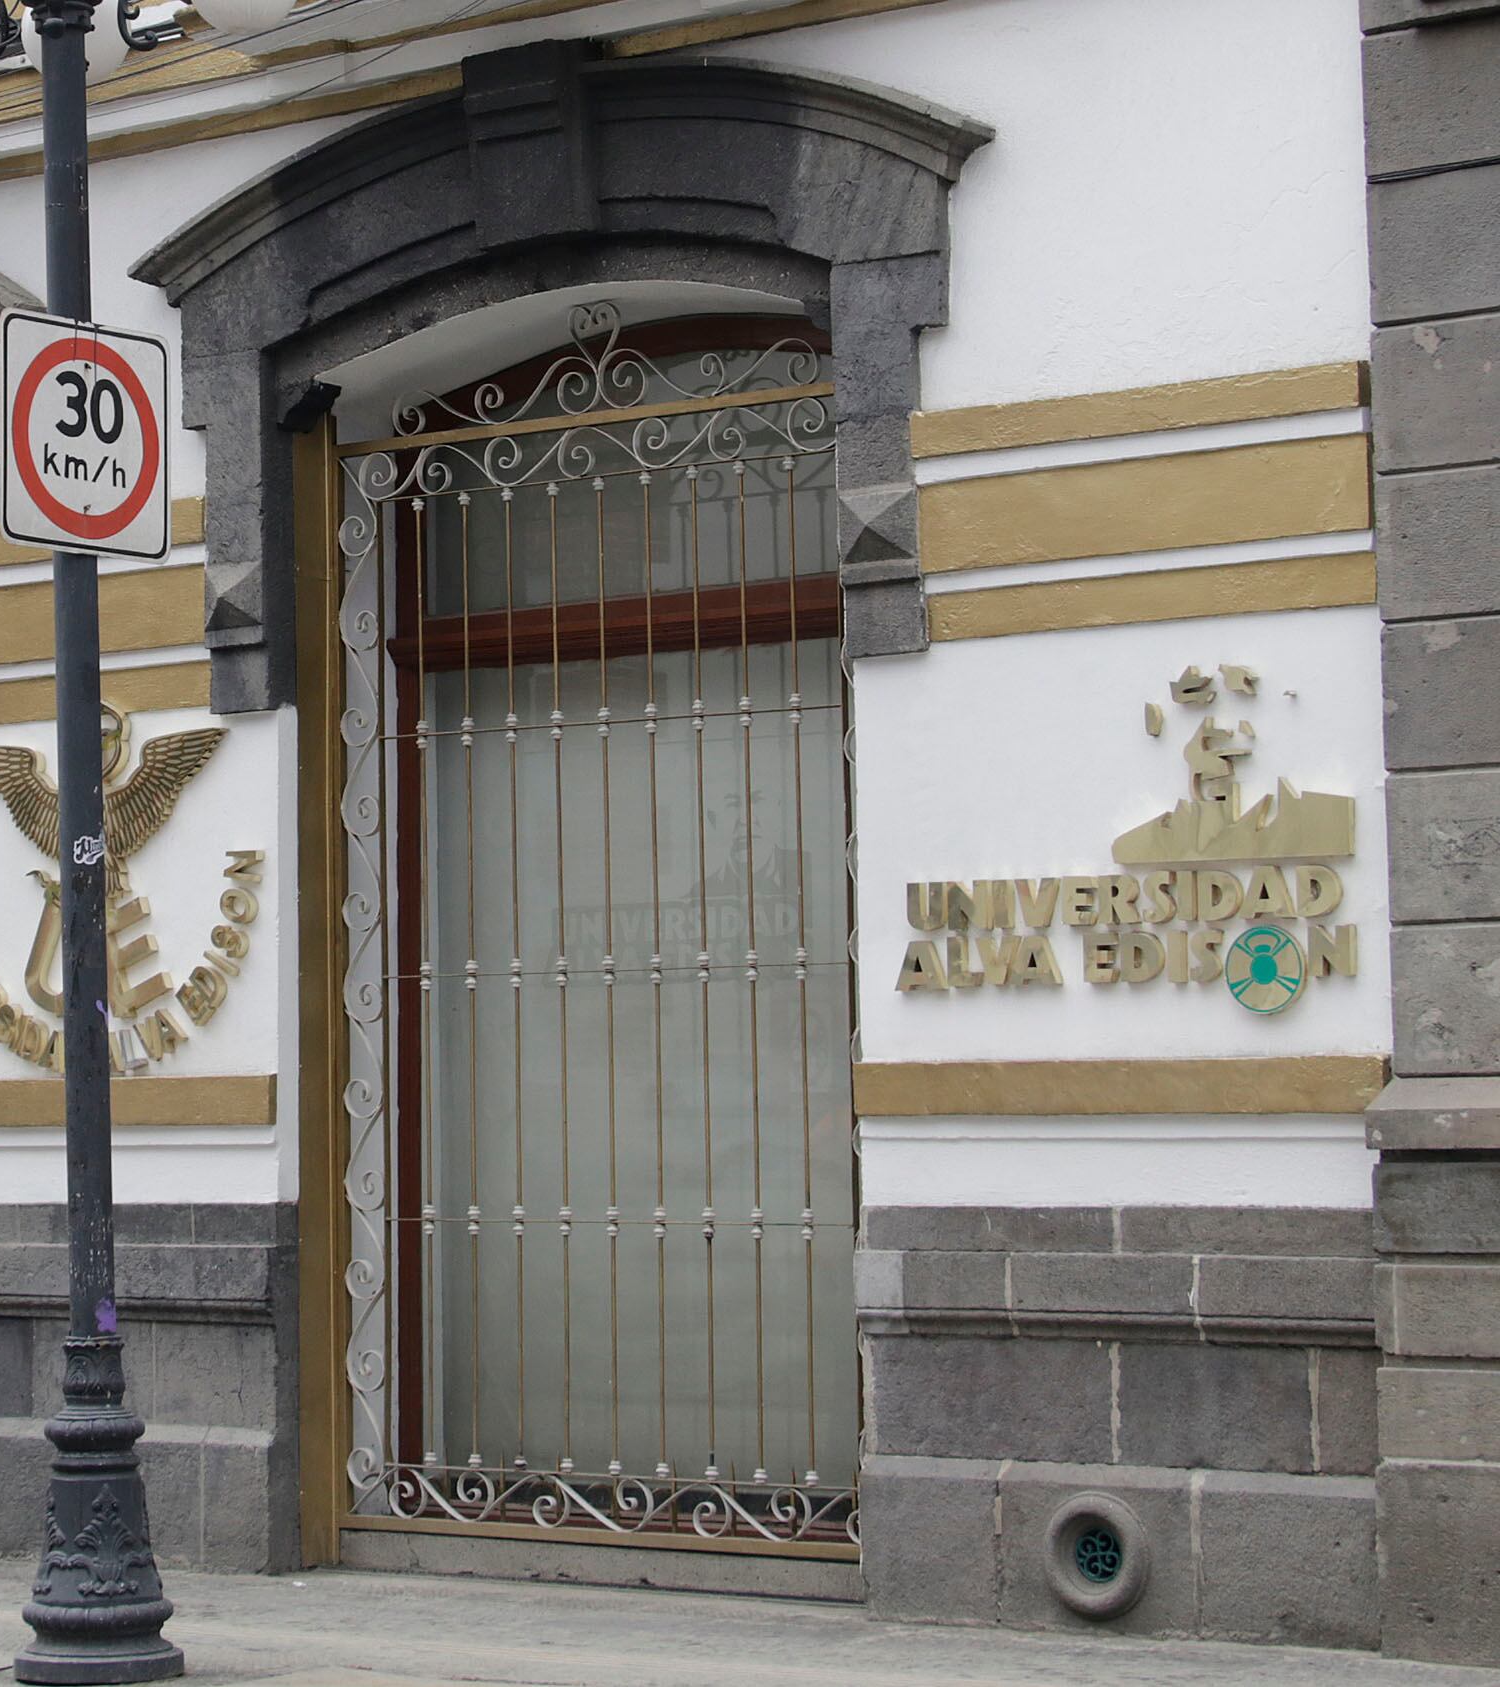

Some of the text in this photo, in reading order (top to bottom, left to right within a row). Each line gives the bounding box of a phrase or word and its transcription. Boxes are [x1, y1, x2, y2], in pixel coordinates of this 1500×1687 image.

[55, 371, 124, 445] 30
[43, 443, 127, 489] km/h
[906, 865, 1345, 932] UNIVERSIDAD
[174, 849, 265, 1027] EDISON
[895, 933, 1064, 992] ALVA
